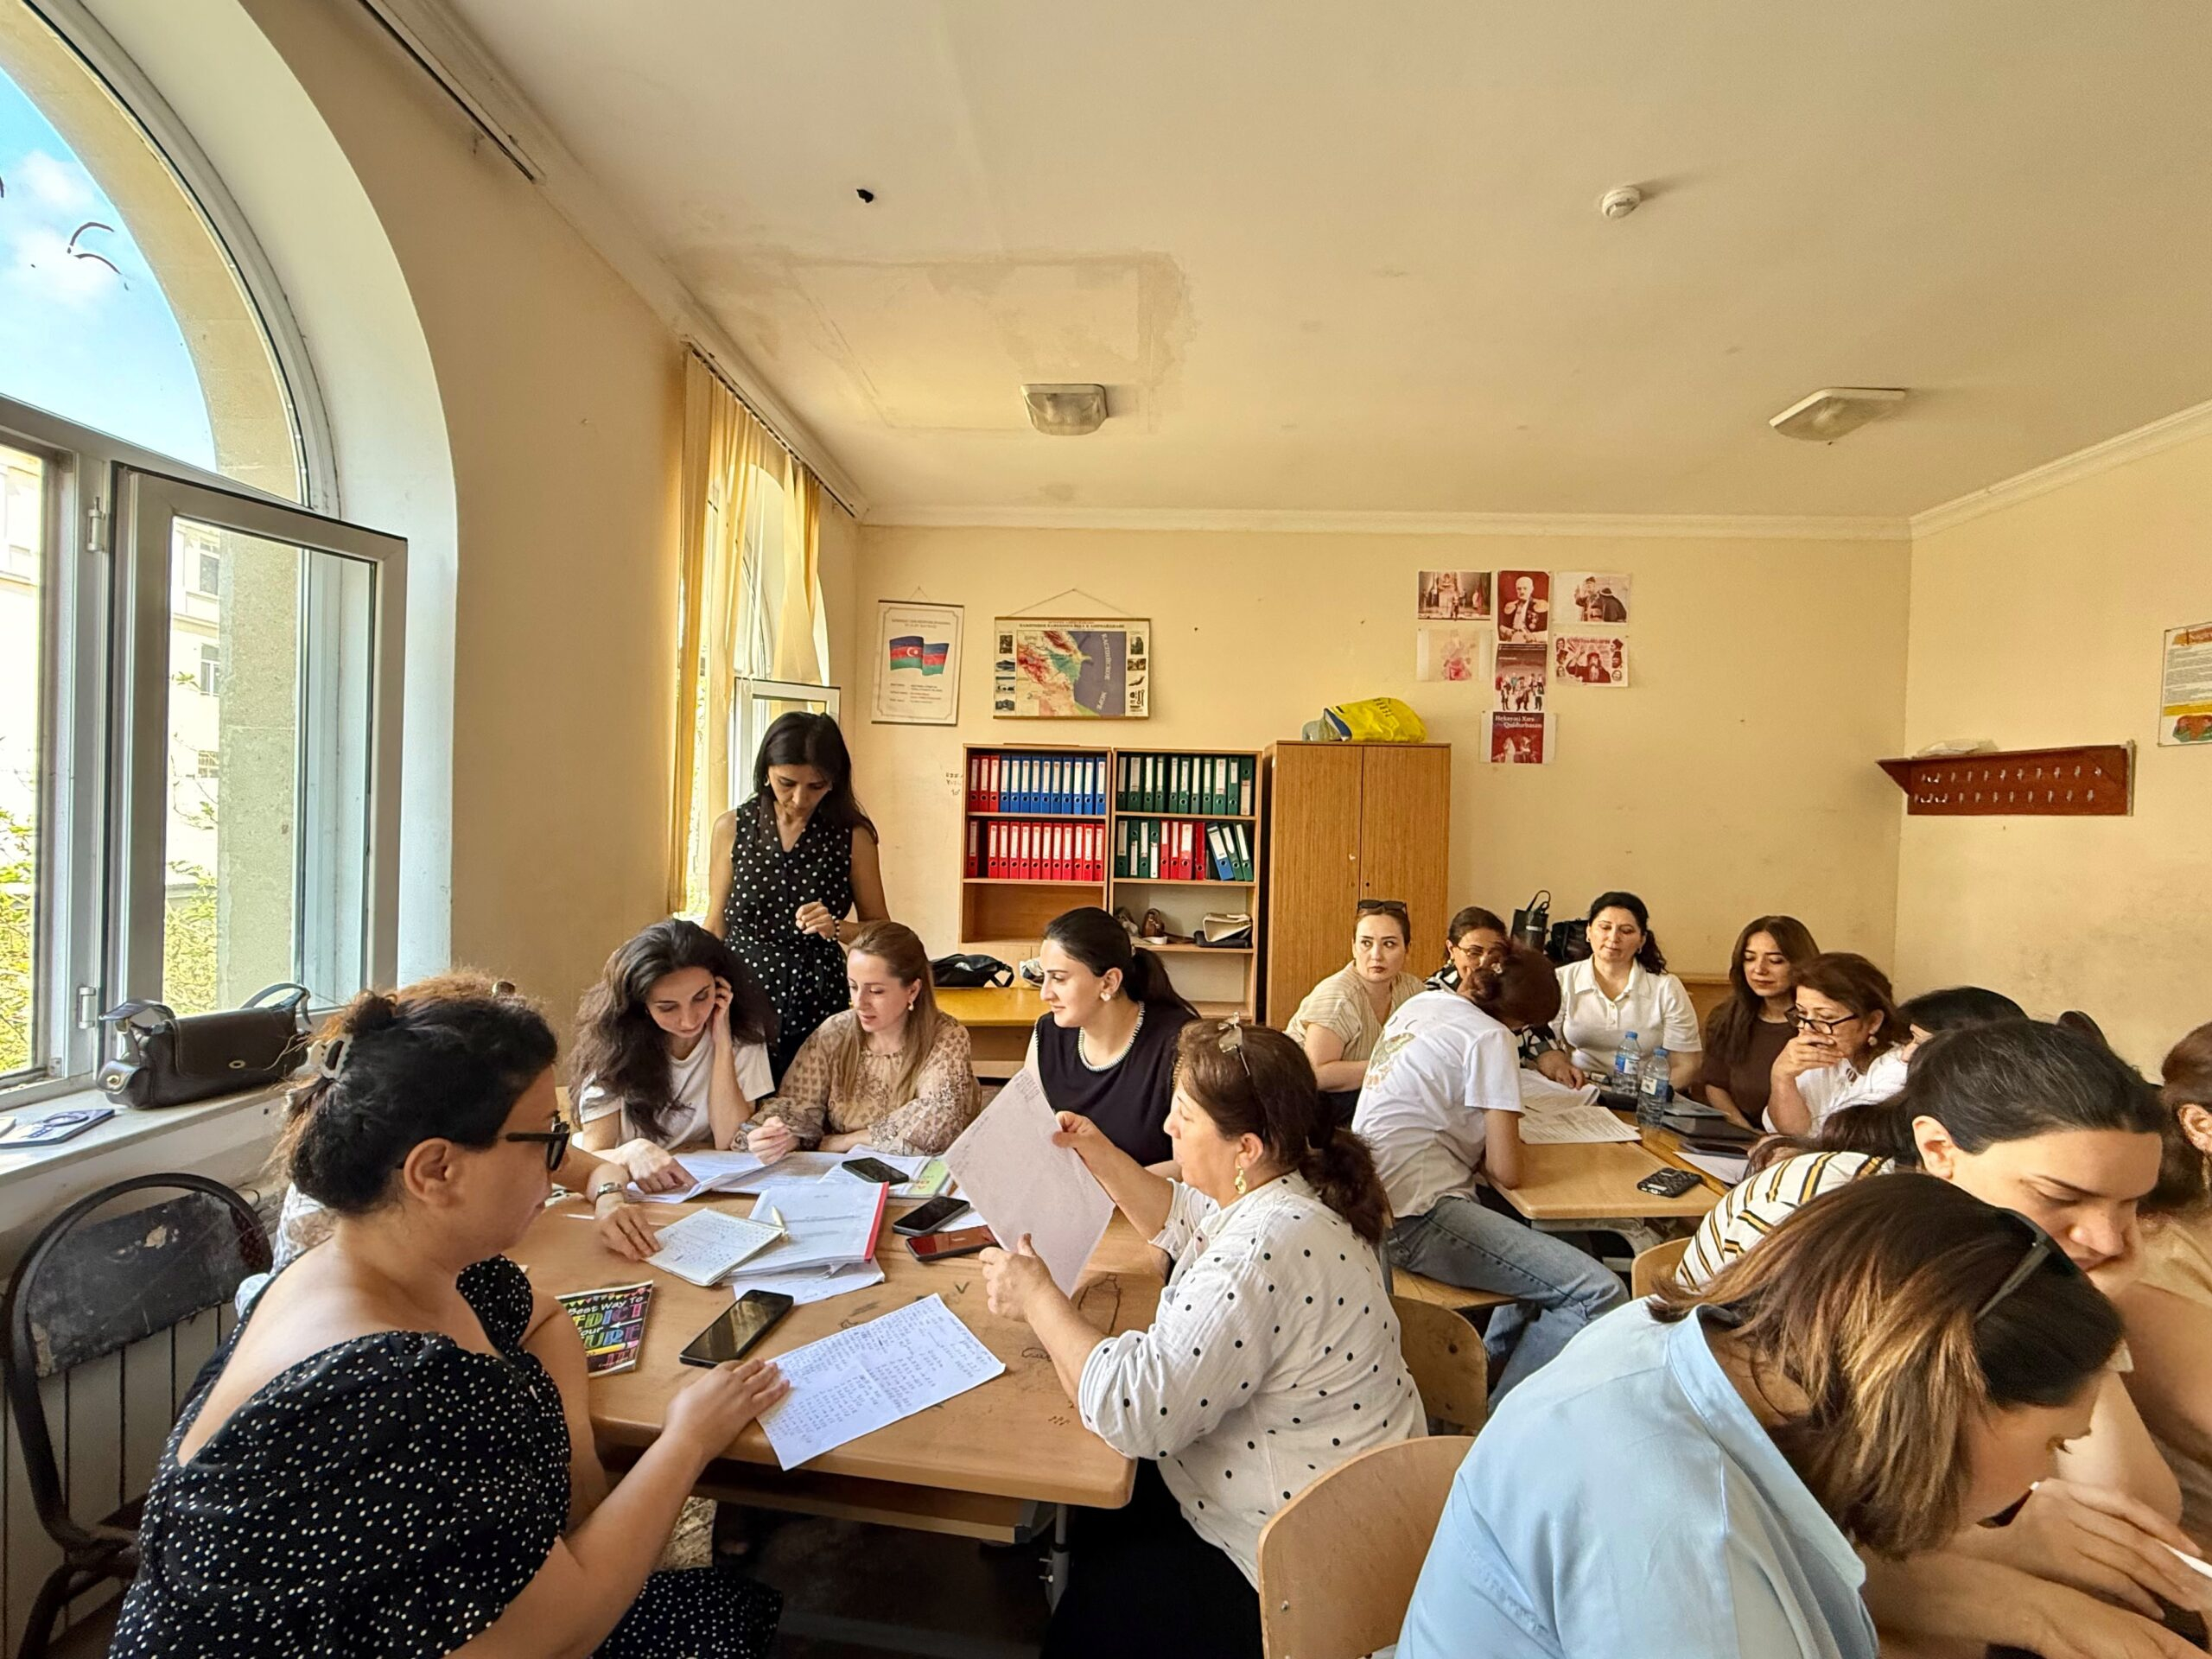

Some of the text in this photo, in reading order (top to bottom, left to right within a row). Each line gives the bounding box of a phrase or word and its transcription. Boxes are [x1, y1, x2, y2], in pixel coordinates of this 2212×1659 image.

[568, 1306, 599, 1316] Best
[601, 1300, 627, 1311] Way
[582, 1325, 640, 1349] URE
